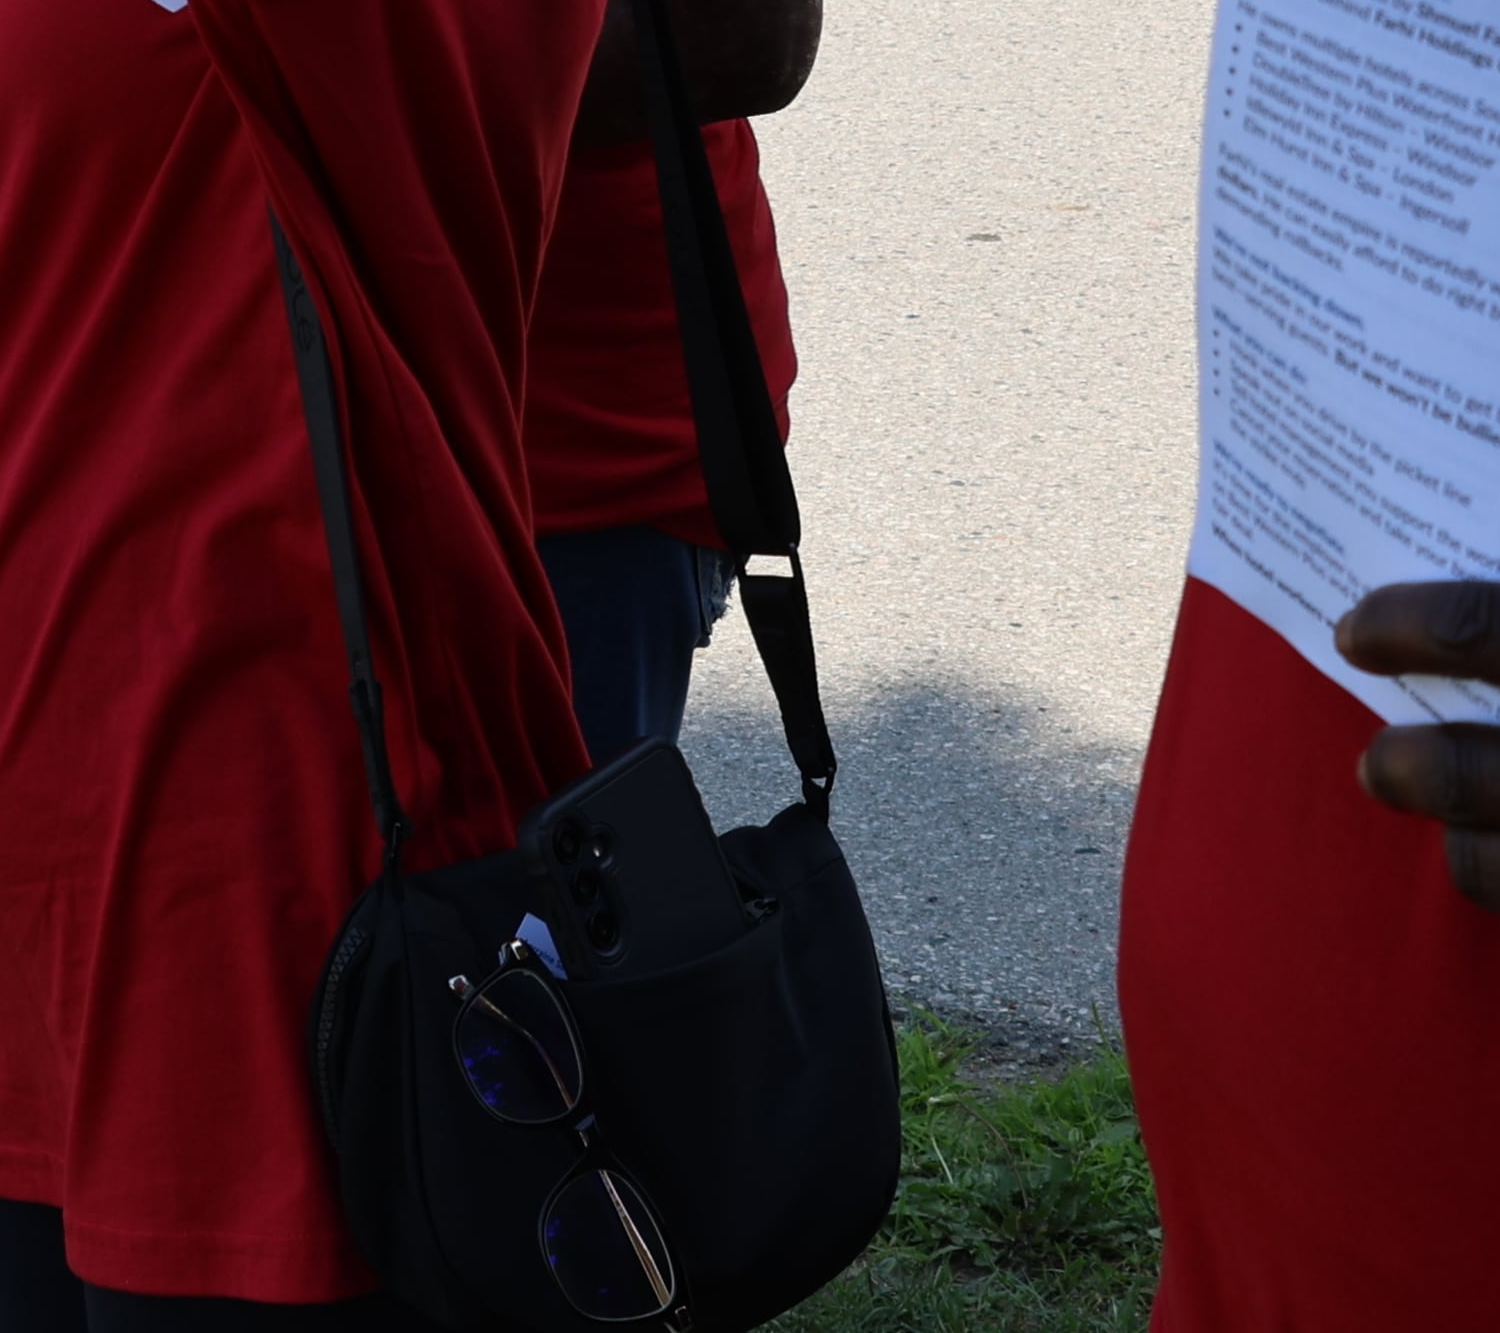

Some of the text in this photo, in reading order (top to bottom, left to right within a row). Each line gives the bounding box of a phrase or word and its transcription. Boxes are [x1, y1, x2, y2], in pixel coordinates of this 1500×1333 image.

[1255, 31, 1287, 55] Best
[1290, 48, 1353, 84] Western
[1355, 75, 1388, 101] Plus
[1259, 12, 1297, 37] owns
[1300, 32, 1362, 66] multiple
[1363, 56, 1413, 87] hotels
[1415, 81, 1470, 109] across
[1373, 9, 1415, 36] Farhi
[1418, 29, 1493, 67] Holdings
[1333, 349, 1359, 373] But
[1360, 369, 1383, 387] we
[1385, 383, 1429, 411] won't
[1431, 402, 1452, 422] be
